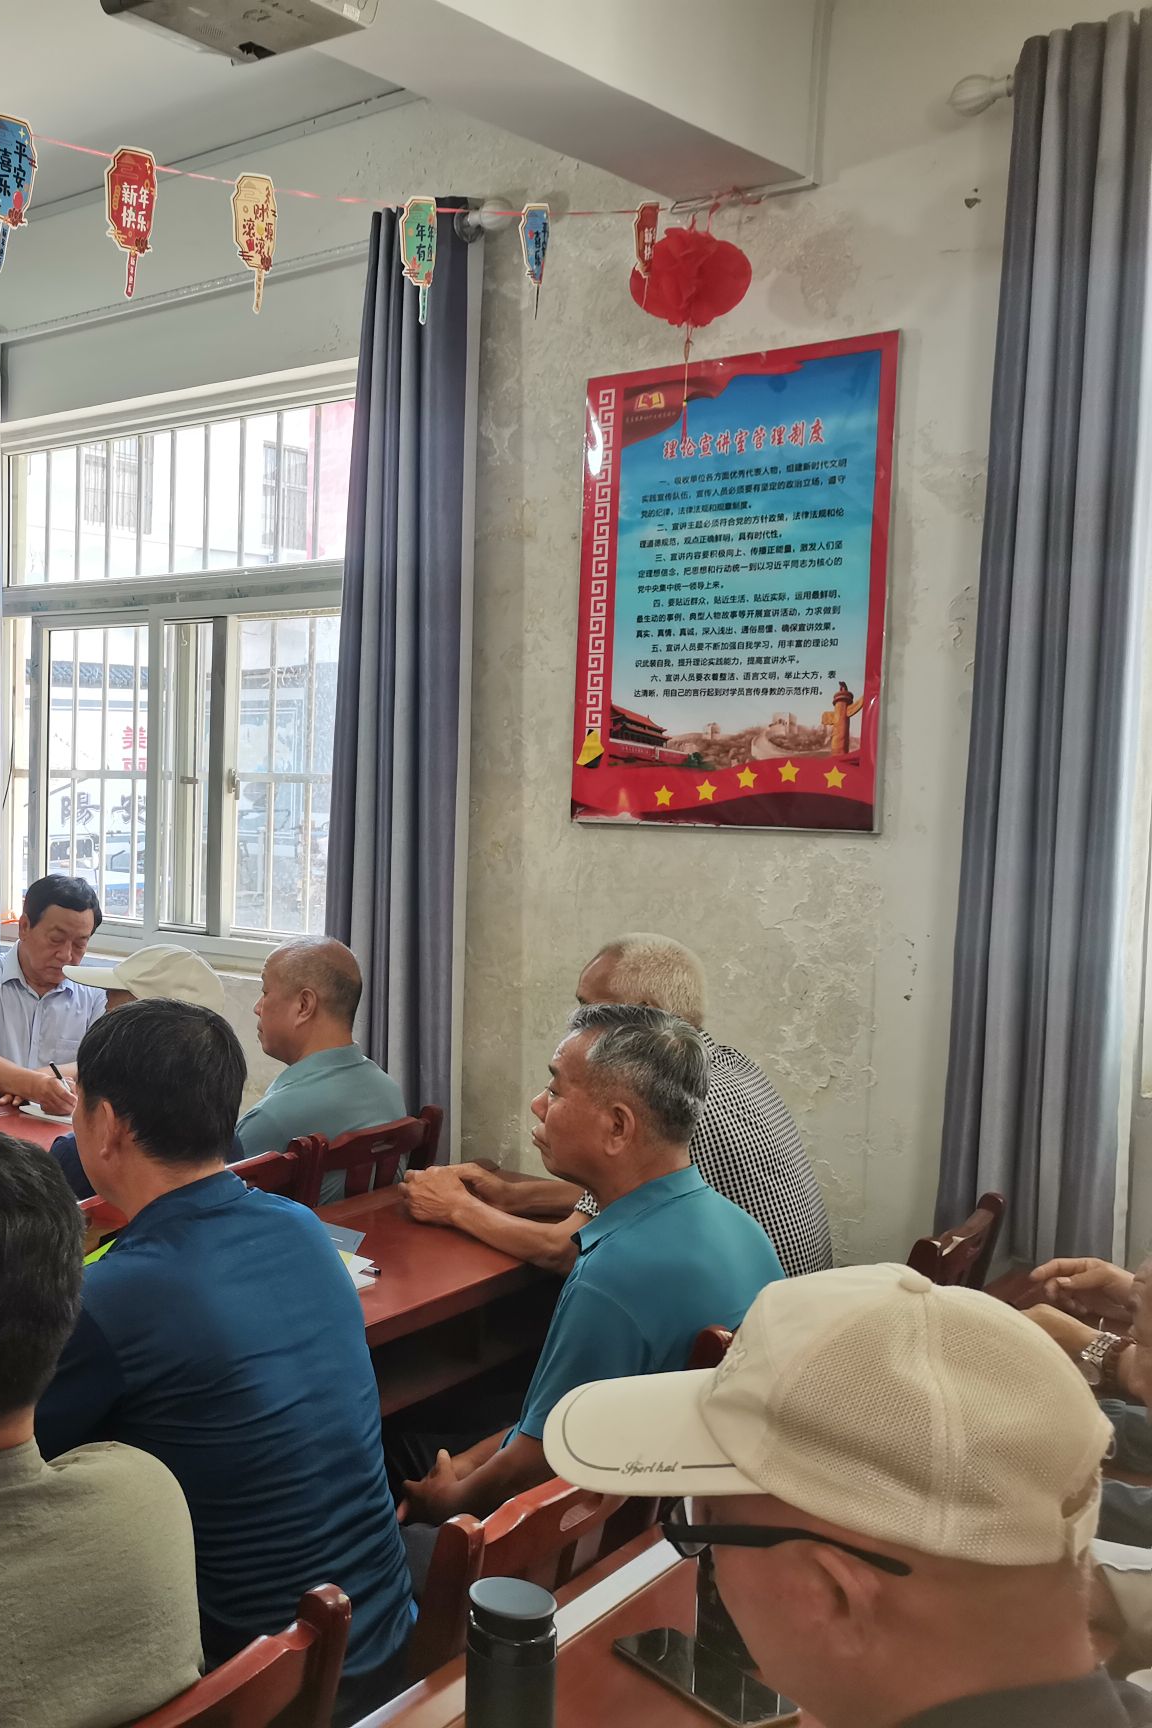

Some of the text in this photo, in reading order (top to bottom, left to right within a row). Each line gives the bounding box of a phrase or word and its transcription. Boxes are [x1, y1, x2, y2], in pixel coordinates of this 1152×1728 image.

[662, 417, 825, 460] 理论宣讲室管理制度
